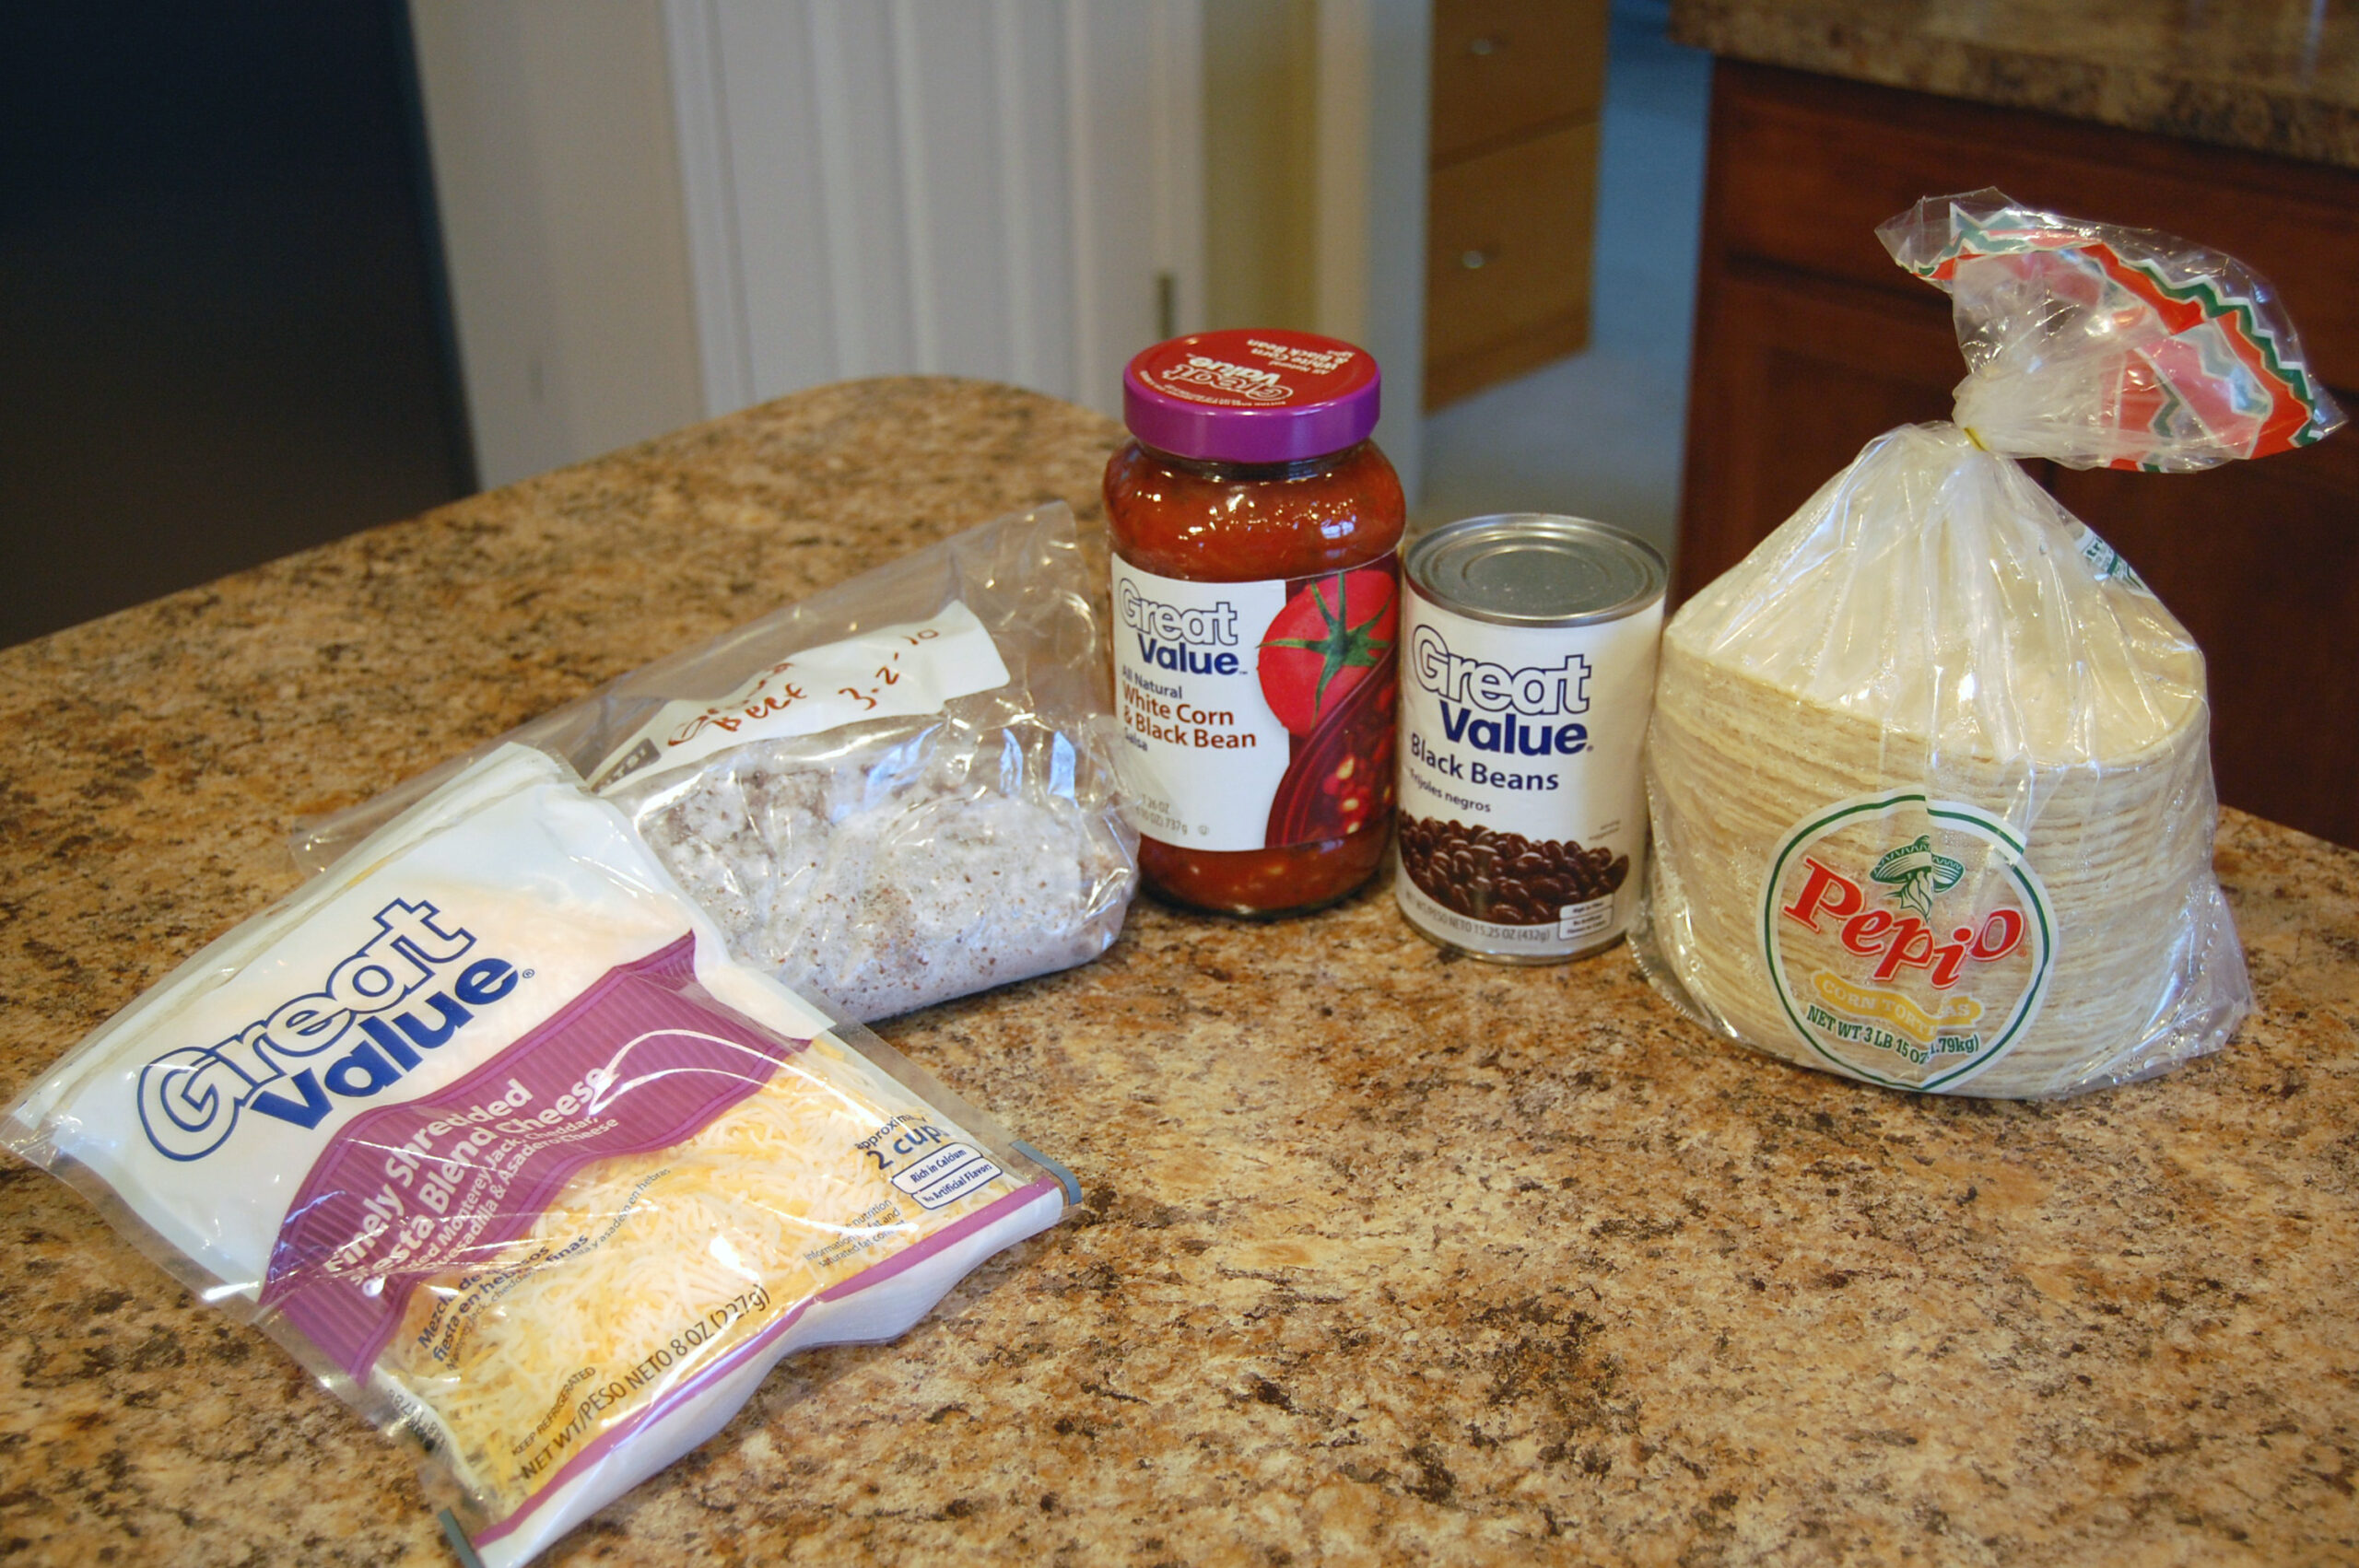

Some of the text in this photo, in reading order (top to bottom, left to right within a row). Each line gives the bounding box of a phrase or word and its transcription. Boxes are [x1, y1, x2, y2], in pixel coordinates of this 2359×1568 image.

[1162, 364, 1293, 401] Great
[1189, 357, 1281, 386] Value
[1119, 578, 1238, 646] Great
[1137, 633, 1239, 674] Value
[1412, 625, 1592, 716] Great
[1122, 680, 1234, 726] White Corn
[1134, 673, 1182, 699] Natural
[1123, 705, 1256, 749] & Black Bean
[1439, 700, 1589, 755] Value
[1411, 731, 1559, 791] Black Beans
[1445, 792, 1491, 813] negros
[1474, 924, 1500, 939] 15.25
[1502, 929, 1517, 940] OZ
[1822, 979, 1875, 1009] CORN
[136, 896, 477, 1162] Great
[250, 958, 519, 1130] Value
[1806, 1004, 1836, 1032] NET
[1837, 1021, 1863, 1039] WT
[1863, 1026, 1872, 1043] 3
[1873, 1030, 1894, 1048] LB
[1896, 1038, 1908, 1059] 15
[1930, 1034, 1979, 1055] 1.79kg)
[384, 1078, 534, 1188] Shredded
[418, 1127, 497, 1215] Blend
[499, 1067, 612, 1135] Cheese
[489, 1182, 506, 1199] &
[499, 1138, 561, 1186] Asadero
[560, 1118, 619, 1142] Cheese
[866, 1150, 894, 1171] 2
[910, 1148, 967, 1184] Rich in Calcium
[933, 1176, 967, 1199] Artificial
[965, 1162, 992, 1183] Flavors
[437, 1168, 493, 1246] Monterey
[852, 1199, 893, 1226] nutrition
[883, 1207, 901, 1225] and
[433, 1315, 461, 1362] fiesta
[459, 1293, 480, 1314] en
[545, 1235, 588, 1262] finas
[459, 1275, 483, 1291] de
[521, 1283, 772, 1480] NET WT/PESO NETO 8 OZ (227g)
[511, 1366, 597, 1457] KEEP REFRIGERATED
